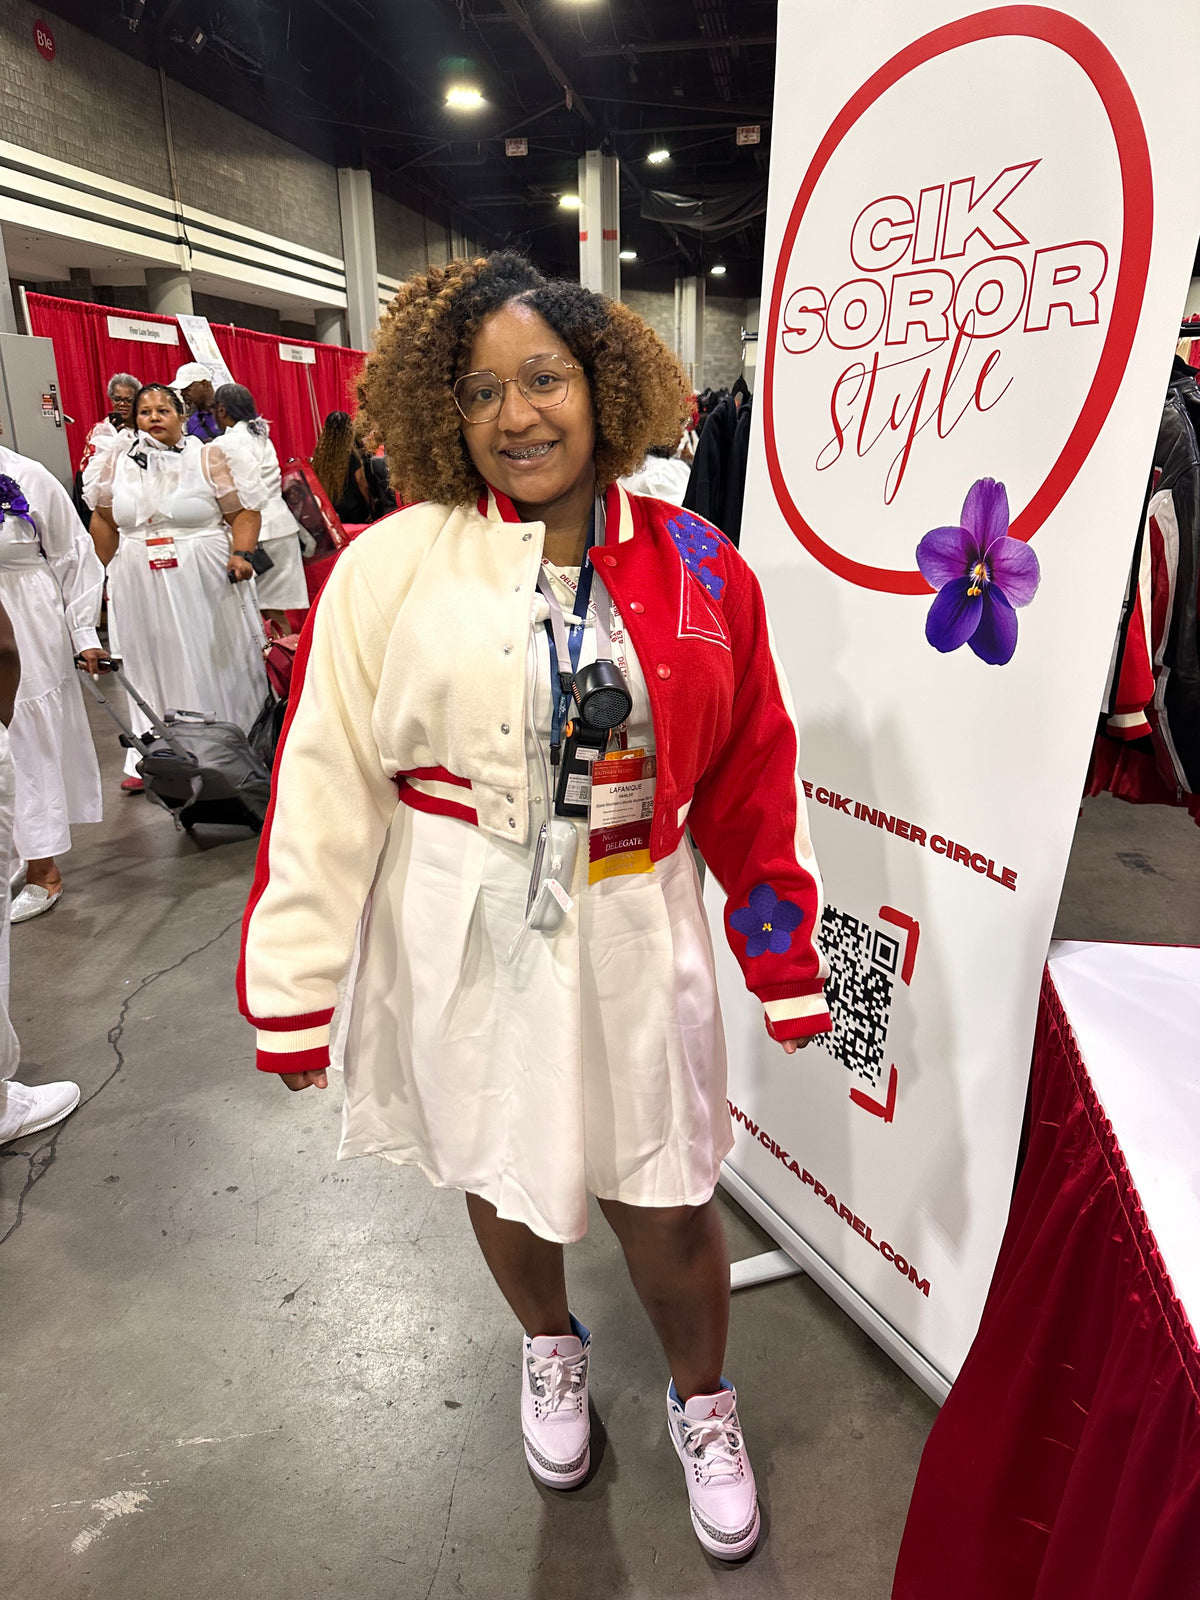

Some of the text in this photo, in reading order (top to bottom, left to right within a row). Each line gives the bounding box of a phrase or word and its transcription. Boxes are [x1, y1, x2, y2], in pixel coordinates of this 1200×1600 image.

[36, 29, 53, 51] B1e
[850, 158, 1043, 272] CIK
[781, 240, 1109, 354] SOROR
[815, 309, 1014, 505] style
[609, 783, 642, 794] LAFANIQUE
[815, 787, 854, 816] CIK
[854, 801, 927, 847] INNER
[929, 834, 1018, 892] CIRCLE
[605, 837, 643, 852] DELEGATE
[727, 1099, 931, 1298] WW.CIKAPPAREL.COM
